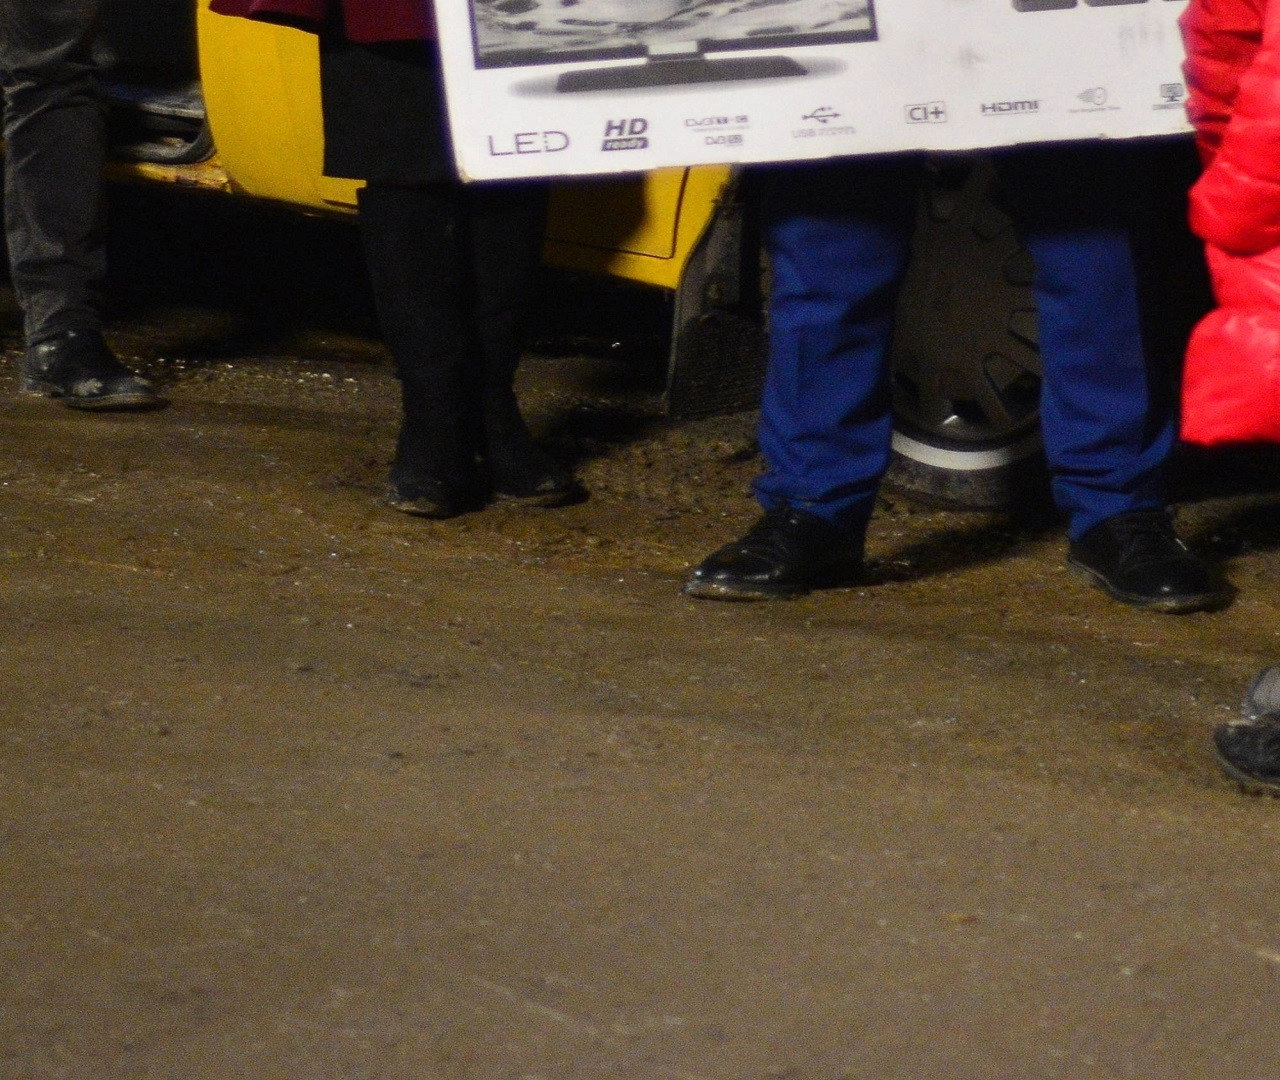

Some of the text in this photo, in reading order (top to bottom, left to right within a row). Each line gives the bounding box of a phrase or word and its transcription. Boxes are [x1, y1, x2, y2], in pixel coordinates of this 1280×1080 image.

[980, 100, 1039, 114] HDMI
[604, 118, 649, 137] HD
[487, 130, 570, 157] LED
